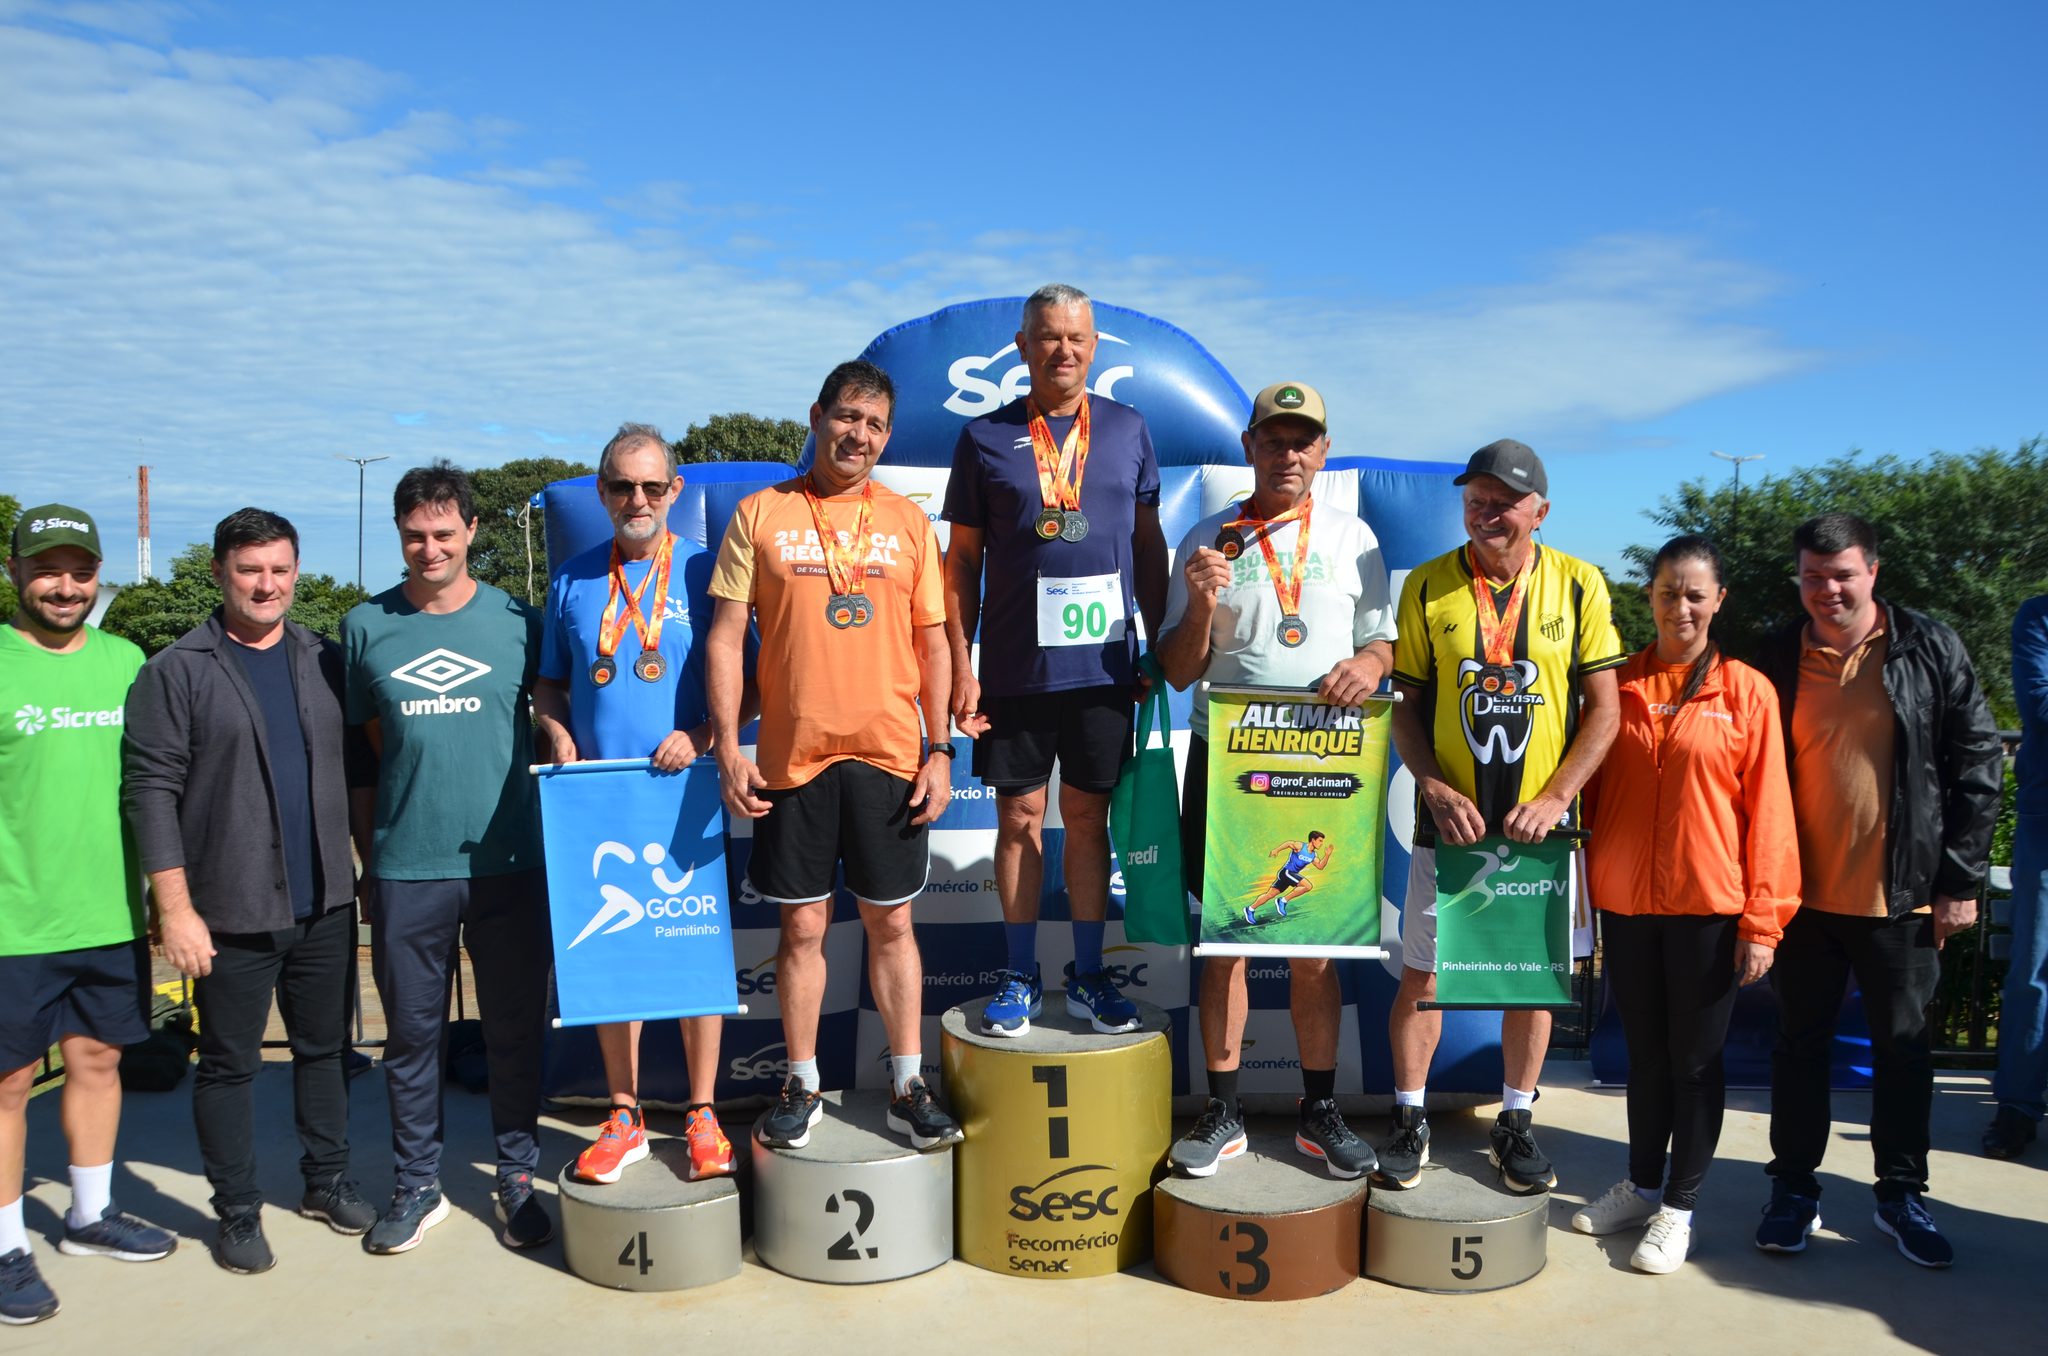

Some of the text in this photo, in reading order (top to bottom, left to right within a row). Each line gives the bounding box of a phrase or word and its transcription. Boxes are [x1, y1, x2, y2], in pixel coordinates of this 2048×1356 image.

[943, 356, 1134, 417] Sec
[46, 518, 89, 533] Sicredi
[780, 544, 897, 566] REGAL
[1233, 568, 1261, 587] 34
[1062, 601, 1107, 639] 90
[51, 705, 124, 729] Sicred
[400, 694, 482, 716] umbro
[1242, 703, 1362, 730] ALCIMAR
[1231, 728, 1362, 757] HENRIQUE
[986, 786, 997, 800] R
[1270, 776, 1352, 790] @prof_alcimarh
[1495, 879, 1567, 896] acorPV
[645, 894, 718, 919] GCOR
[655, 924, 721, 938] Palmitinho
[978, 970, 1000, 984] RS
[1442, 961, 1502, 972] Pinheirinho
[1504, 962, 1518, 972] do
[1519, 962, 1542, 972] Vale
[1551, 963, 1565, 973] RS
[730, 1057, 789, 1081] Ses
[1031, 1065, 1069, 1159] 1
[1008, 1185, 1119, 1222] Sesc
[825, 1189, 878, 1261] 2
[617, 1231, 654, 1276] 4
[1007, 1231, 1119, 1252] Fecomércio
[1008, 1255, 1070, 1273] Senac
[1218, 1221, 1271, 1296] 3
[1450, 1235, 1485, 1281] 5
